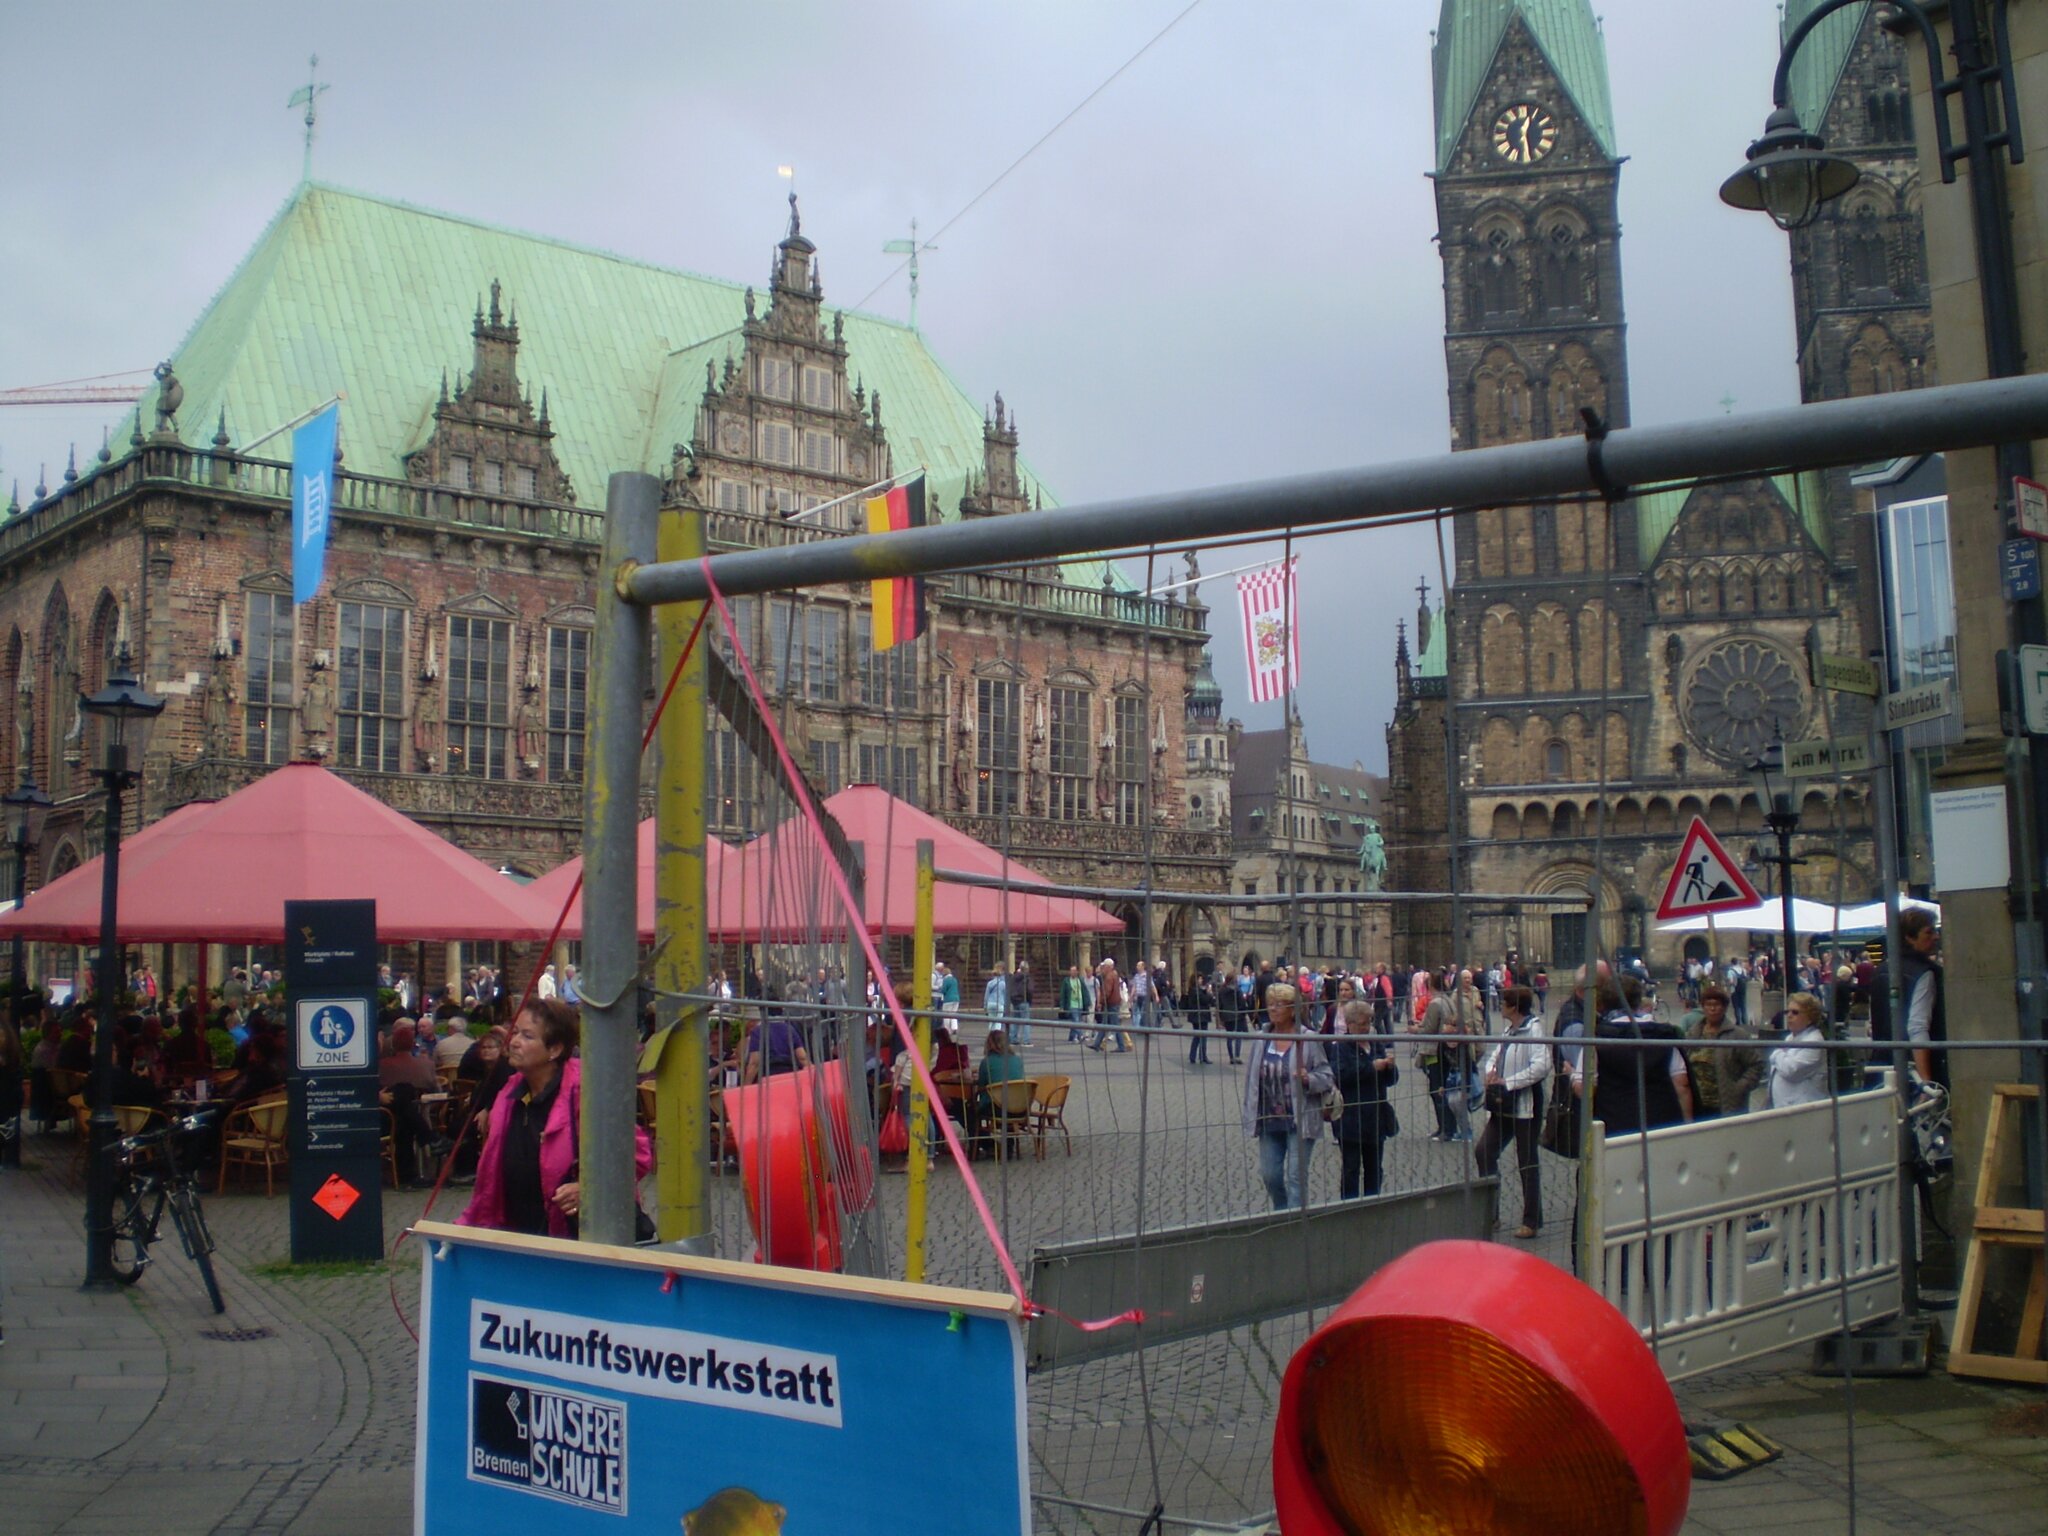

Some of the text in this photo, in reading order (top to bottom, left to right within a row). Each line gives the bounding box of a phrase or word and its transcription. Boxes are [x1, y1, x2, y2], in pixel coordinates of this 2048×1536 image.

[1817, 663, 1872, 686] angenstraße
[1888, 688, 1941, 721] Stintbrücke
[1791, 753, 1814, 768] Am
[316, 1052, 350, 1063] ZONE
[479, 1311, 835, 1409] Zukunftswerkstatt
[529, 1393, 621, 1456] UNSERE
[474, 1445, 529, 1479] Bremen
[532, 1442, 621, 1504] SCHULE
